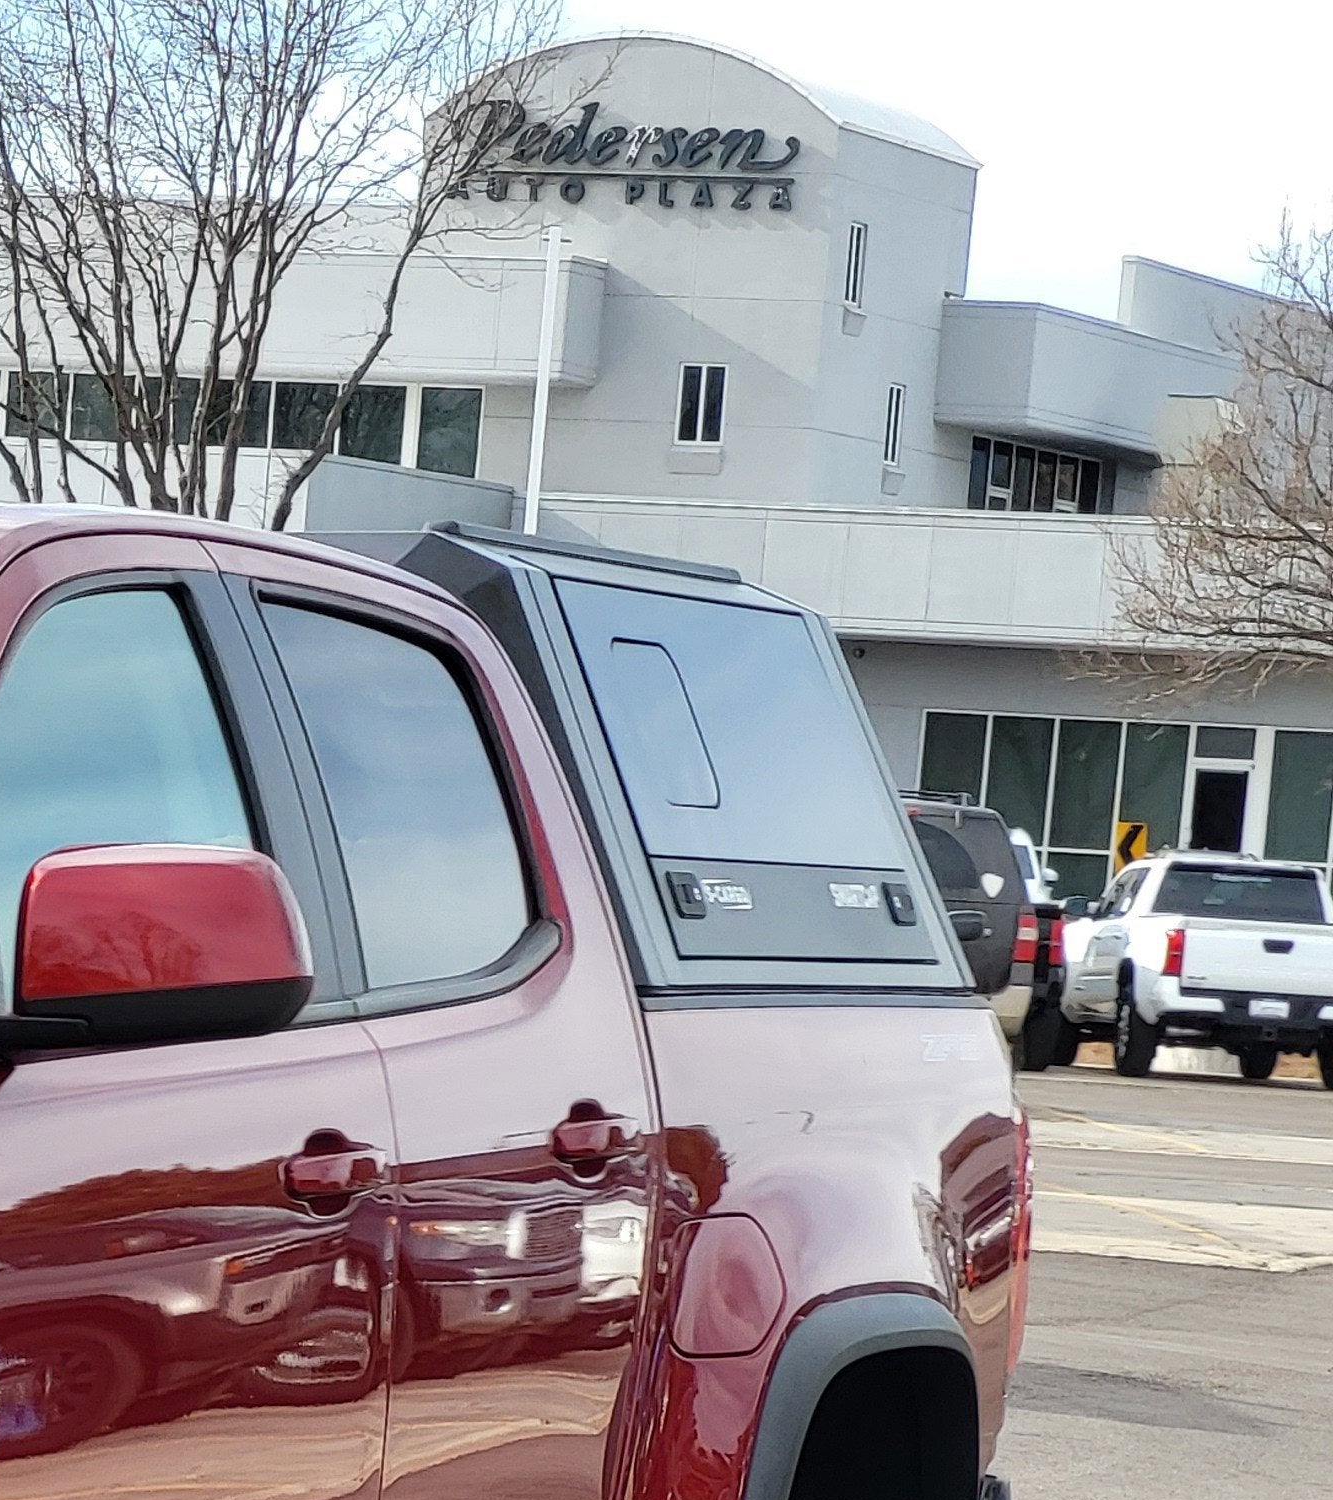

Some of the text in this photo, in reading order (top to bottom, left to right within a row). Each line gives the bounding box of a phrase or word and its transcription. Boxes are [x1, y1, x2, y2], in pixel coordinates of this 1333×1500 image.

[451, 99, 801, 171] Pedersen
[446, 177, 792, 211] AUTO PLAZA
